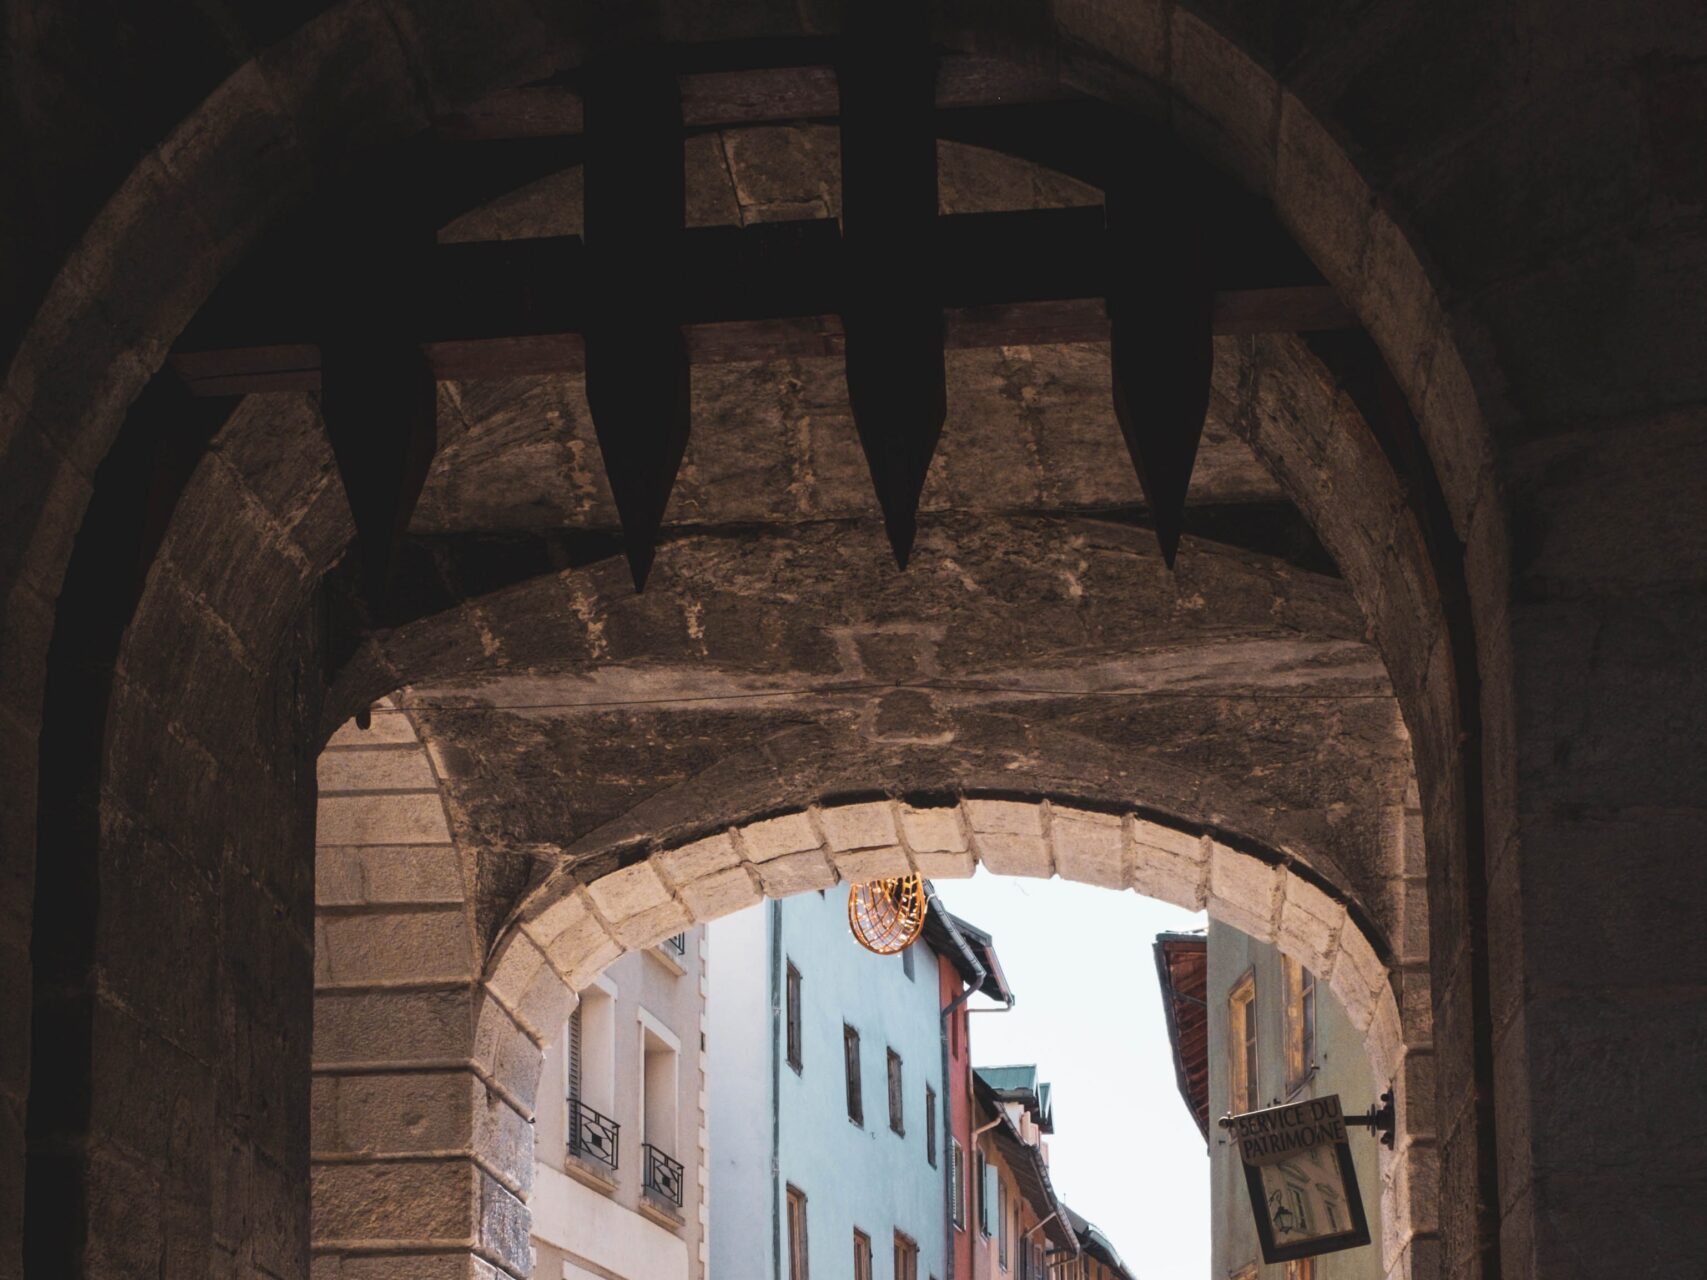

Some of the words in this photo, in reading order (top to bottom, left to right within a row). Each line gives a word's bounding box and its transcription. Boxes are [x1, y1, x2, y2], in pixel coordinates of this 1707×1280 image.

[1239, 1105, 1304, 1137] SERVICE
[1311, 1097, 1338, 1121] DU
[1244, 1120, 1344, 1159] PATRIMOINE
